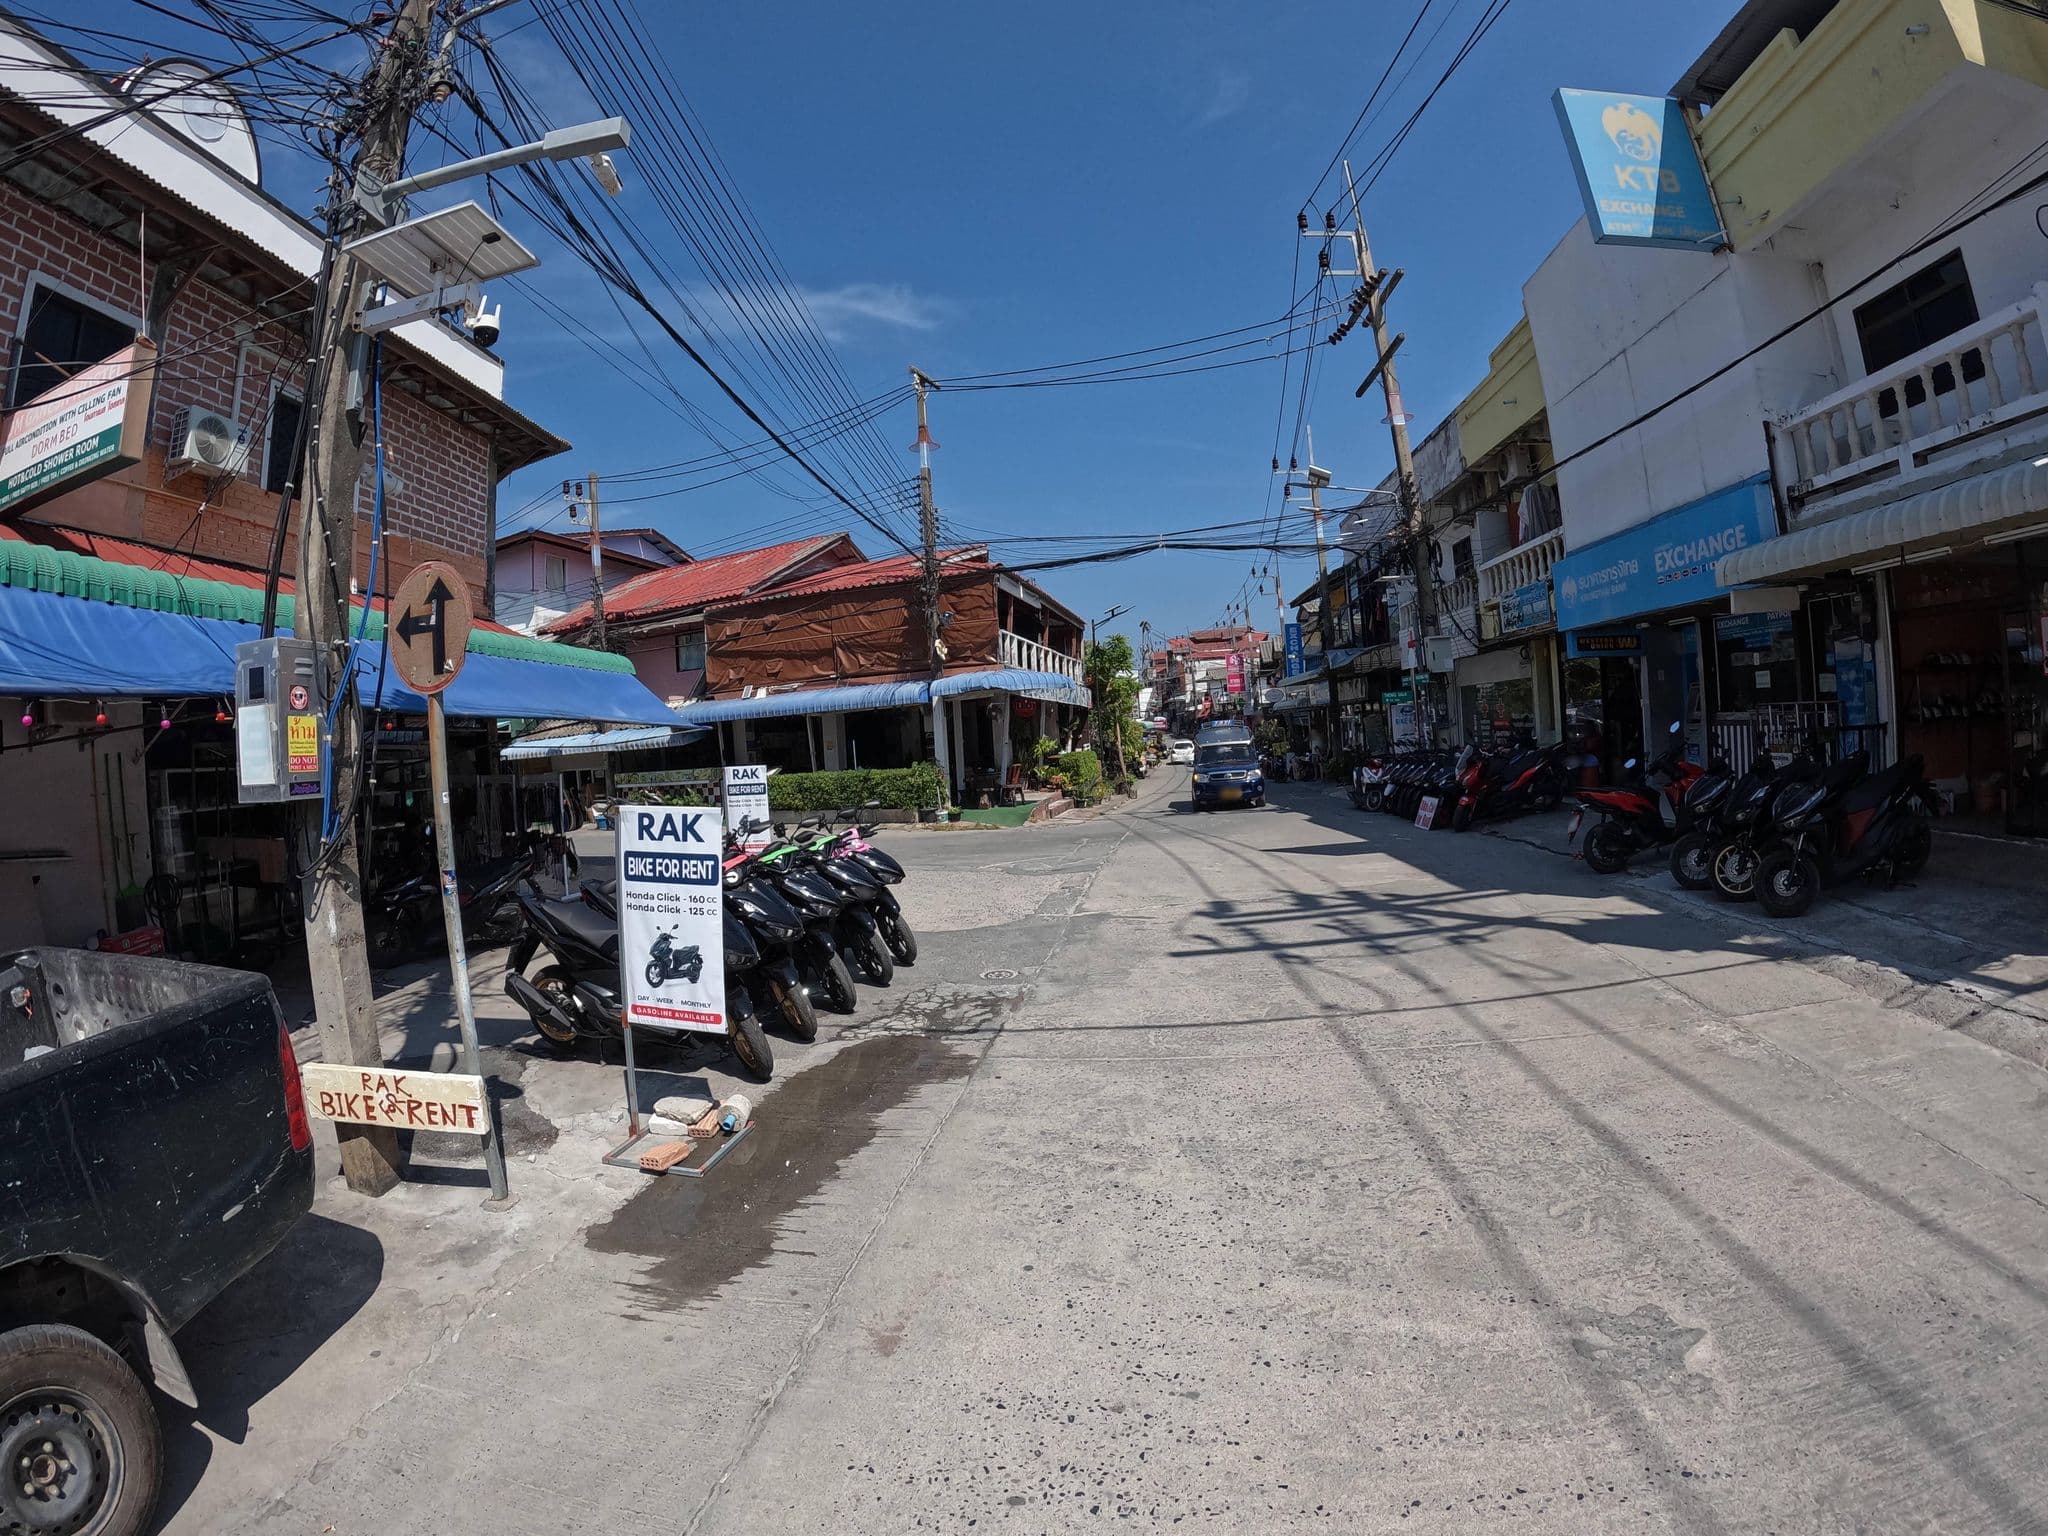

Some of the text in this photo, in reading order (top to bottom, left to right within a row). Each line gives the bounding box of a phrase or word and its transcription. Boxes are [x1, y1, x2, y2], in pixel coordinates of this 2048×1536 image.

[1613, 163, 1681, 193] KTB
[1599, 199, 1687, 218] EXCHANGE
[58, 408, 76, 425] WITH
[77, 393, 106, 415] CILLING
[107, 385, 122, 401] FAN
[31, 422, 79, 459] DORM BED
[7, 435, 100, 490] HOT&COLD SHOWER ROOM
[1655, 523, 1747, 573] EXCHANGE
[290, 717, 316, 740] ห้าม
[290, 756, 317, 765] DO NOT
[732, 767, 760, 780] RAK
[729, 785, 764, 794] BIKE FOR RENT
[637, 812, 705, 843] RAK
[628, 857, 714, 880] BIKE FOR RENT
[626, 891, 655, 900] Honda
[656, 892, 680, 902] Click
[689, 895, 705, 904] 160
[626, 902, 655, 912] Honda
[656, 904, 681, 914] Click
[689, 907, 705, 916] 125
[636, 1007, 715, 1022] GASOLINE AVAILABLE
[656, 997, 674, 1005] WEEK
[680, 999, 712, 1009] MONTHLY
[361, 1072, 413, 1098] RAK
[320, 1091, 378, 1121] BIKE
[406, 1098, 479, 1129] RENT
